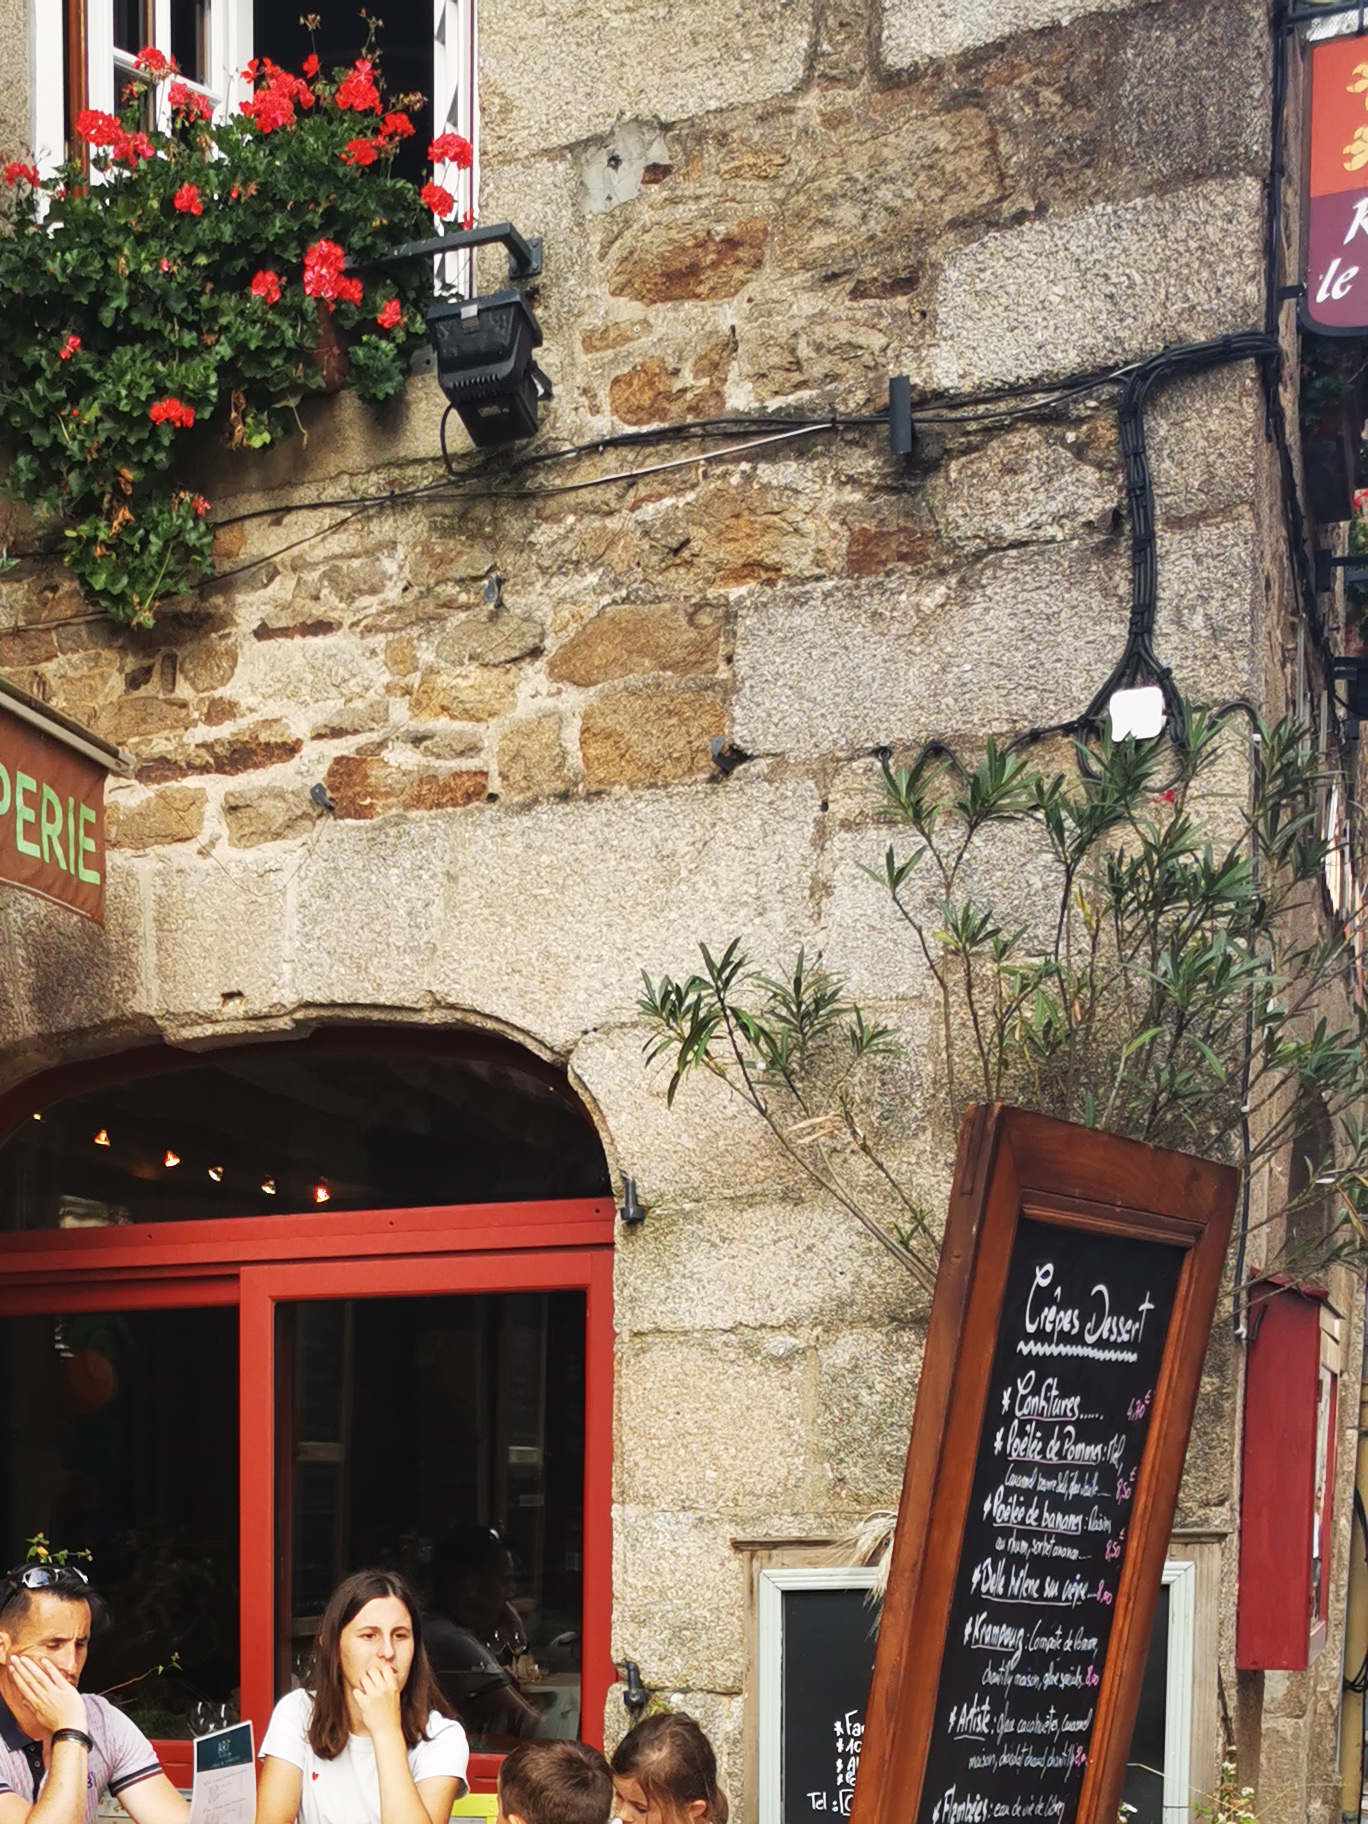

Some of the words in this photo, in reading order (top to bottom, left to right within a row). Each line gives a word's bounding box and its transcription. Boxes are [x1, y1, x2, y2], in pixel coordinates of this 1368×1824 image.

[1315, 257, 1360, 304] le
[1025, 1262, 1080, 1344] Crêpes
[1084, 1284, 1155, 1343] Dessert
[1046, 1425, 1061, 1461] de
[1025, 1495, 1040, 1526] de
